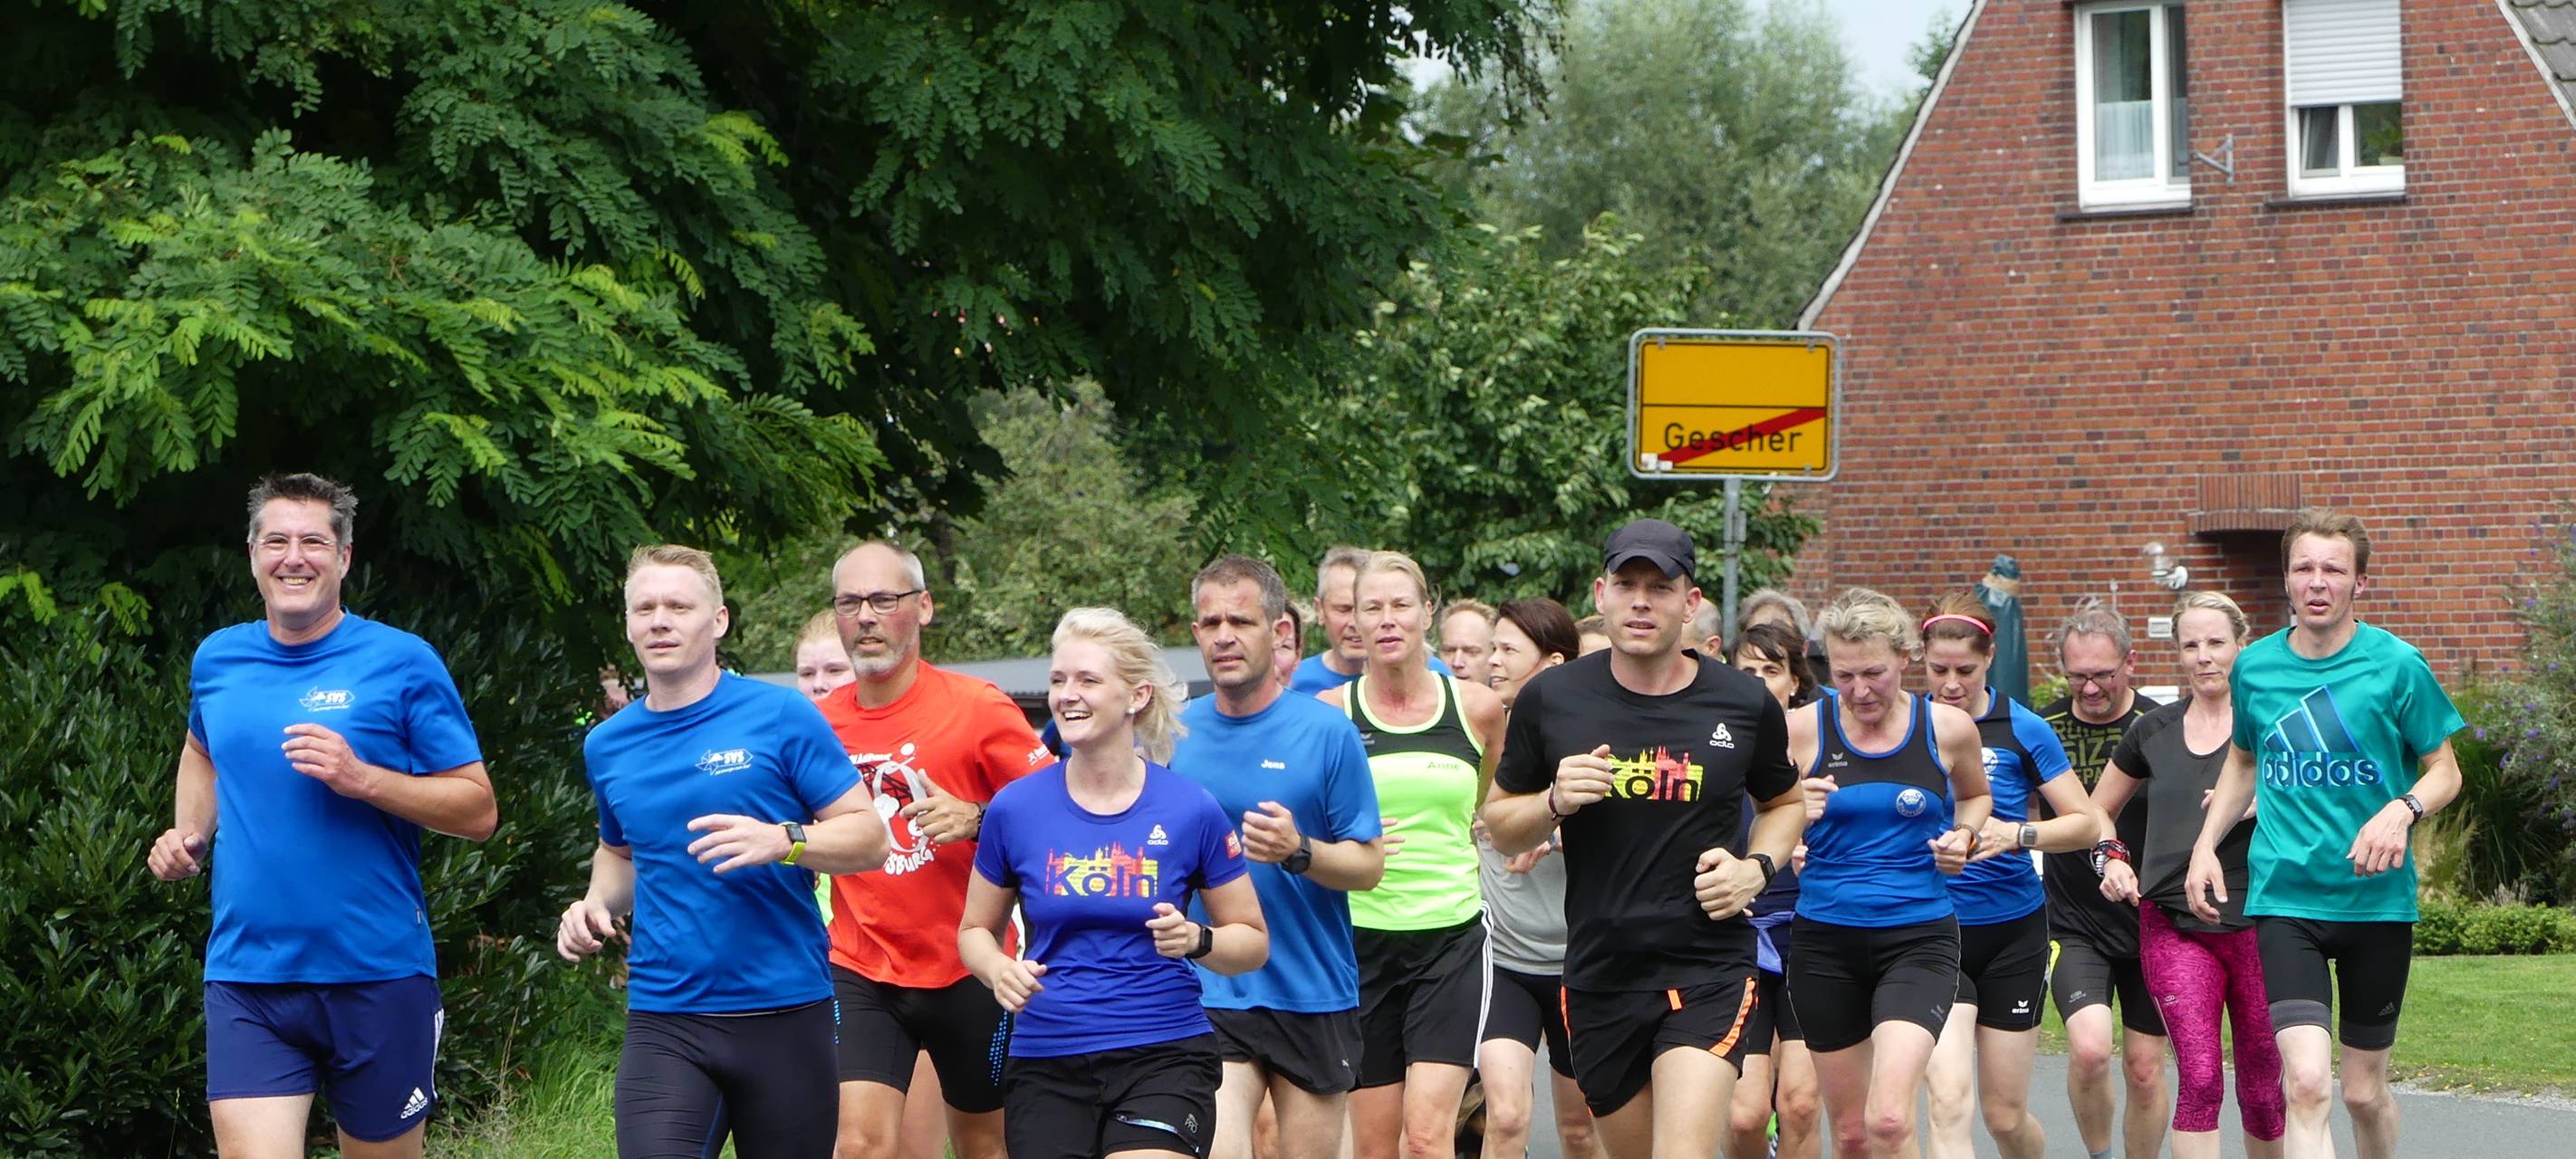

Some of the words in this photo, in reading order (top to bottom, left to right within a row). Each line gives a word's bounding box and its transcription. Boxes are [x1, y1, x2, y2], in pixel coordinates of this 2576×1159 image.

[1665, 422, 1802, 452] Gescher
[2263, 751, 2383, 788] adidas
[1050, 864, 1158, 896] Köln
